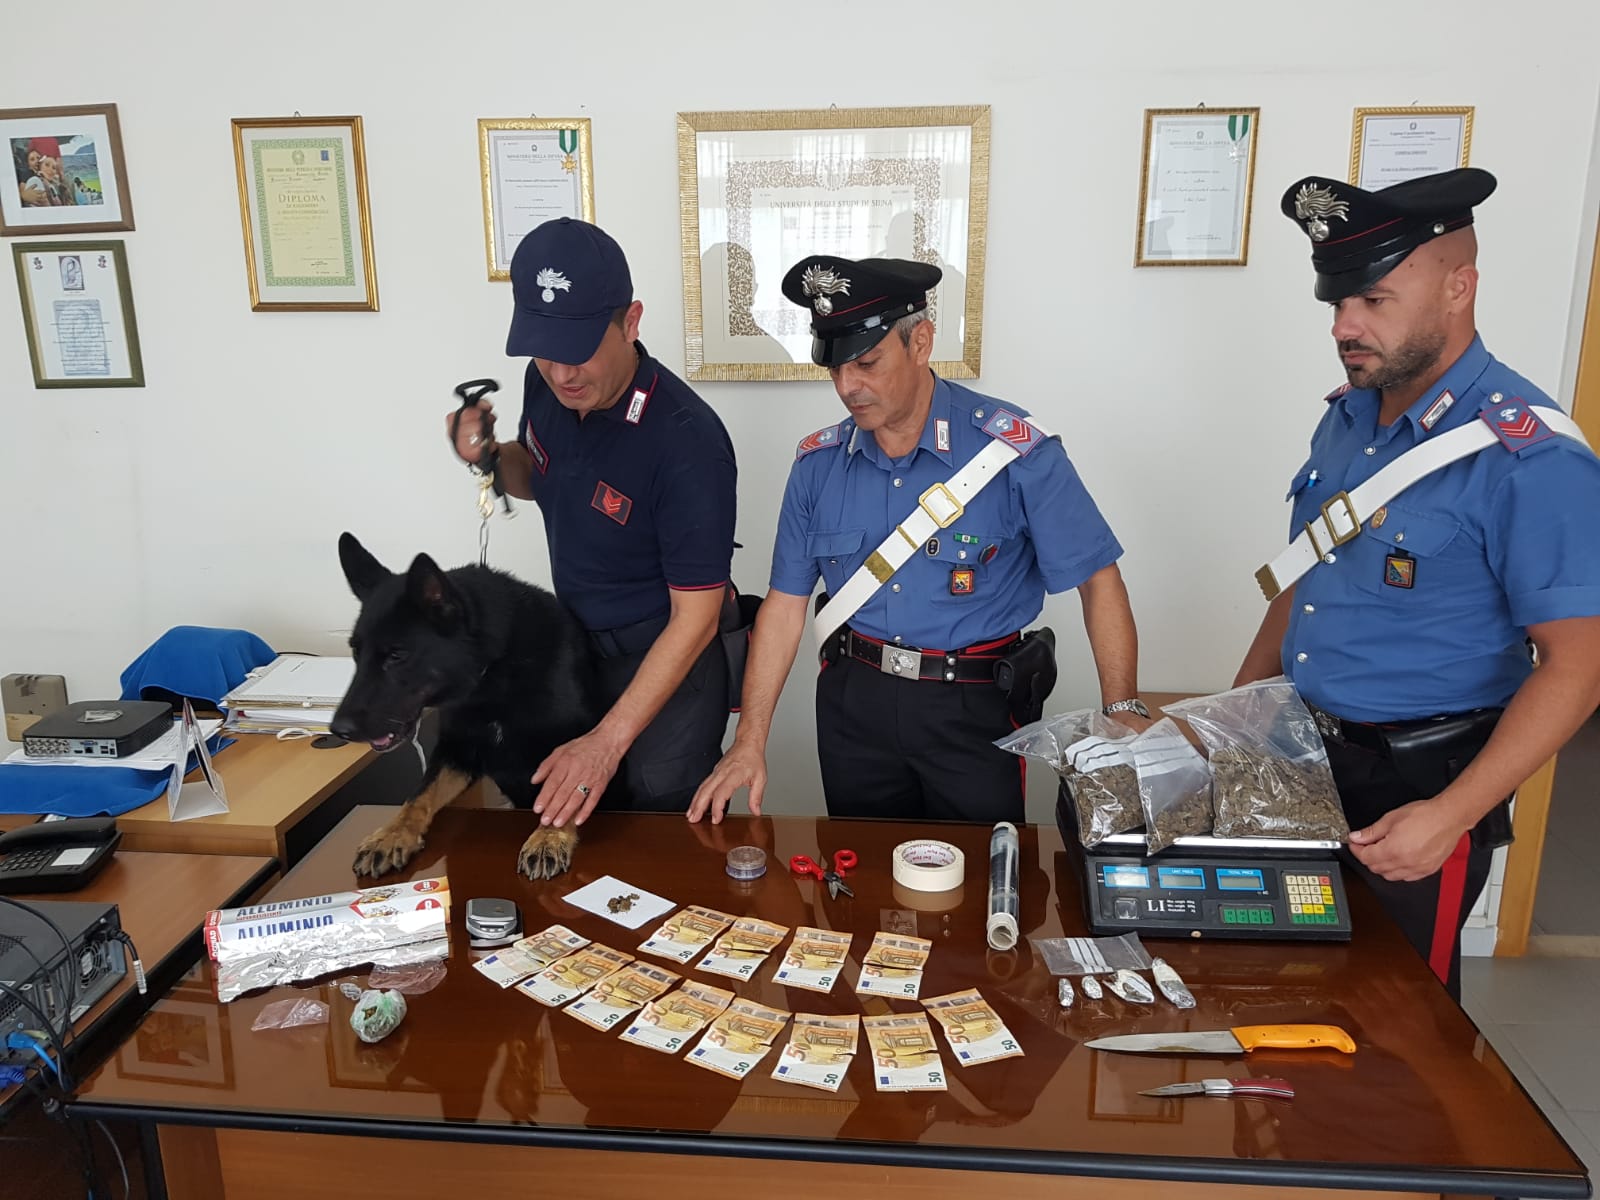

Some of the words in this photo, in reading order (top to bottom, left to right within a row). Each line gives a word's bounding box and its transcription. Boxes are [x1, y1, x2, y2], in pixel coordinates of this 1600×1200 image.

[278, 193, 326, 203] DIPLOMA
[837, 200, 859, 208] STUDI
[237, 896, 332, 917] ALLUMINIO
[658, 924, 681, 941] 50
[679, 950, 693, 959] 50
[713, 940, 734, 958] 50
[785, 952, 806, 969] 50
[544, 964, 569, 981] 50
[739, 965, 753, 975] 50
[819, 976, 832, 987] 50
[592, 982, 615, 1003] 50
[903, 983, 916, 995] 50
[551, 993, 568, 1003] 50
[603, 1013, 619, 1025] 50
[642, 1003, 668, 1026] 50
[666, 1037, 682, 1050] 50
[1001, 1039, 1017, 1051] 50
[786, 1042, 811, 1062] 50
[877, 1048, 899, 1069] 50
[733, 1061, 750, 1073] 50
[824, 1073, 839, 1085] 50
[928, 1071, 942, 1083] 50
